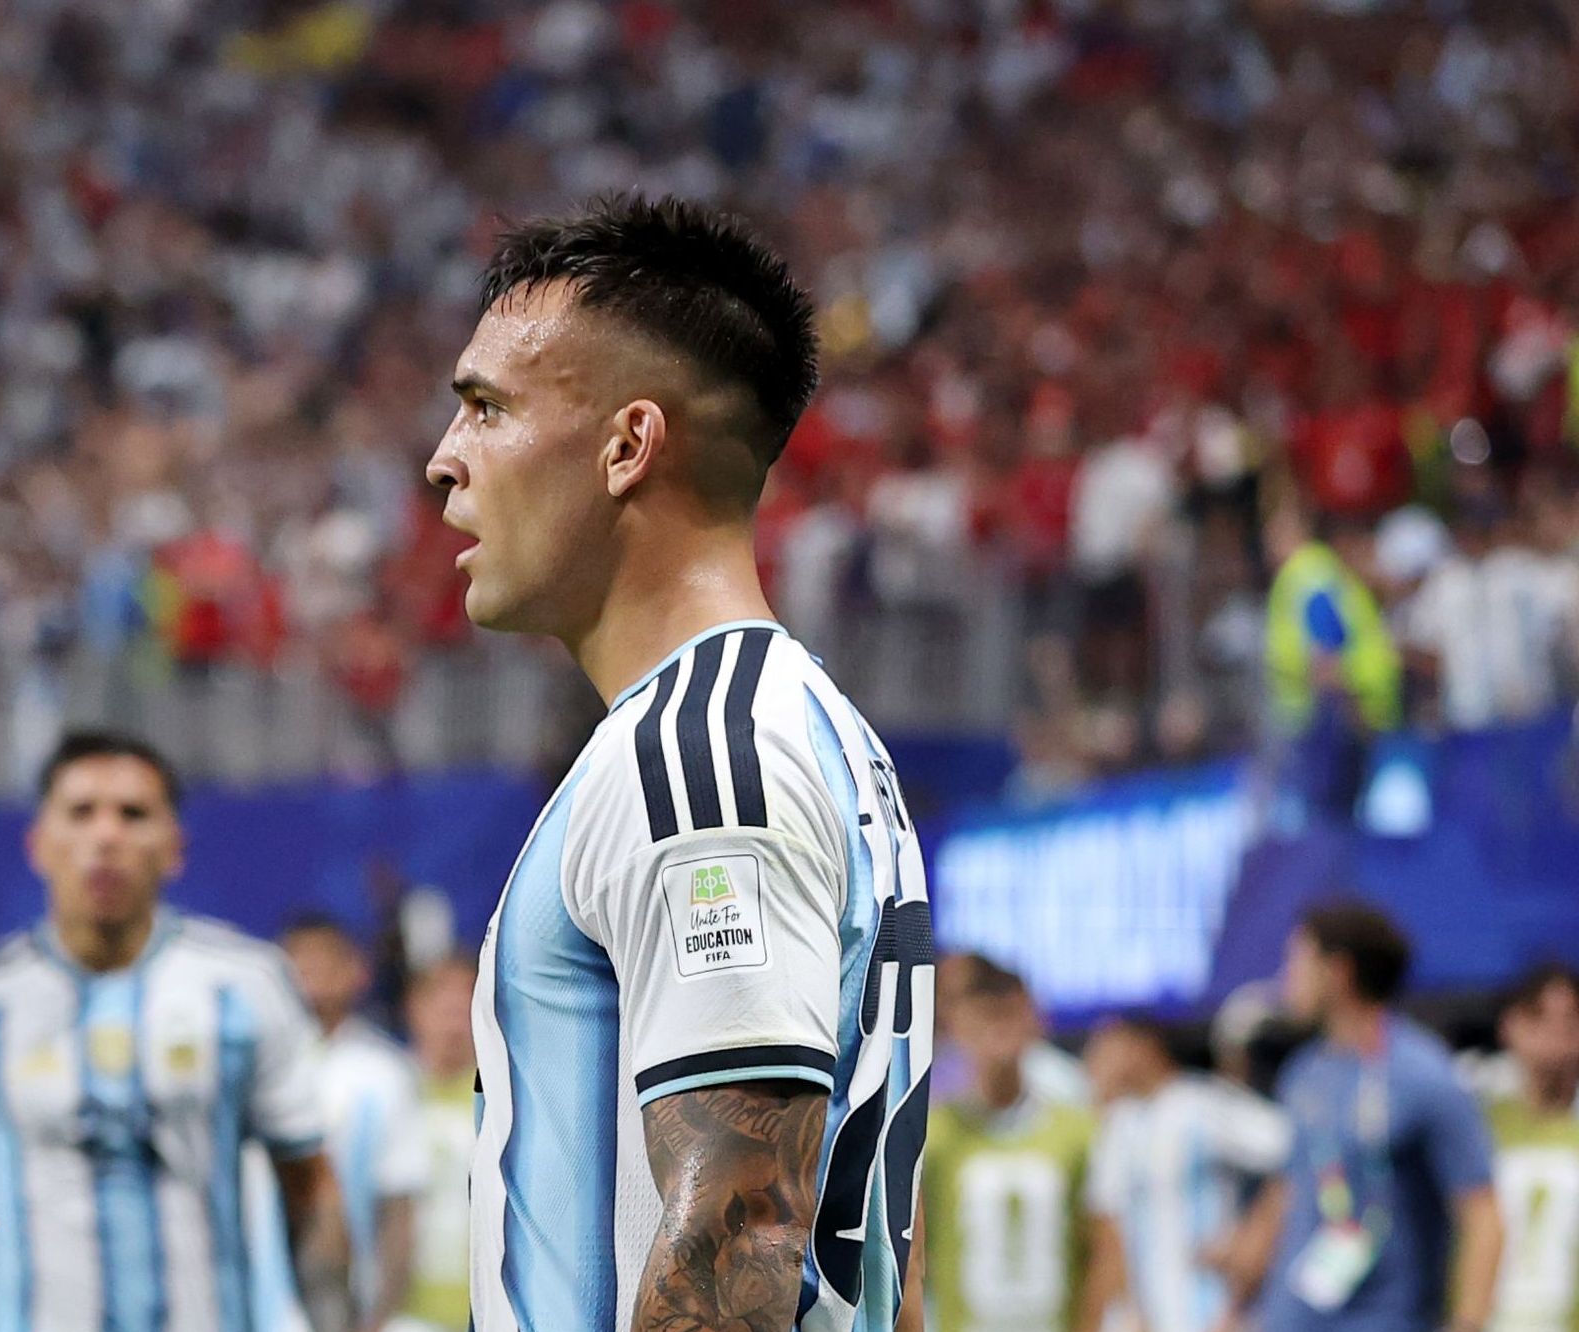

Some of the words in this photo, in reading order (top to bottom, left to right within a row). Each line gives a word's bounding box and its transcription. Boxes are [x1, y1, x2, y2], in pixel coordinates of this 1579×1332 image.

[690, 907, 721, 931] Unite
[722, 904, 741, 925] For
[685, 928, 753, 954] EDUCATION
[706, 951, 731, 963] FIFA
